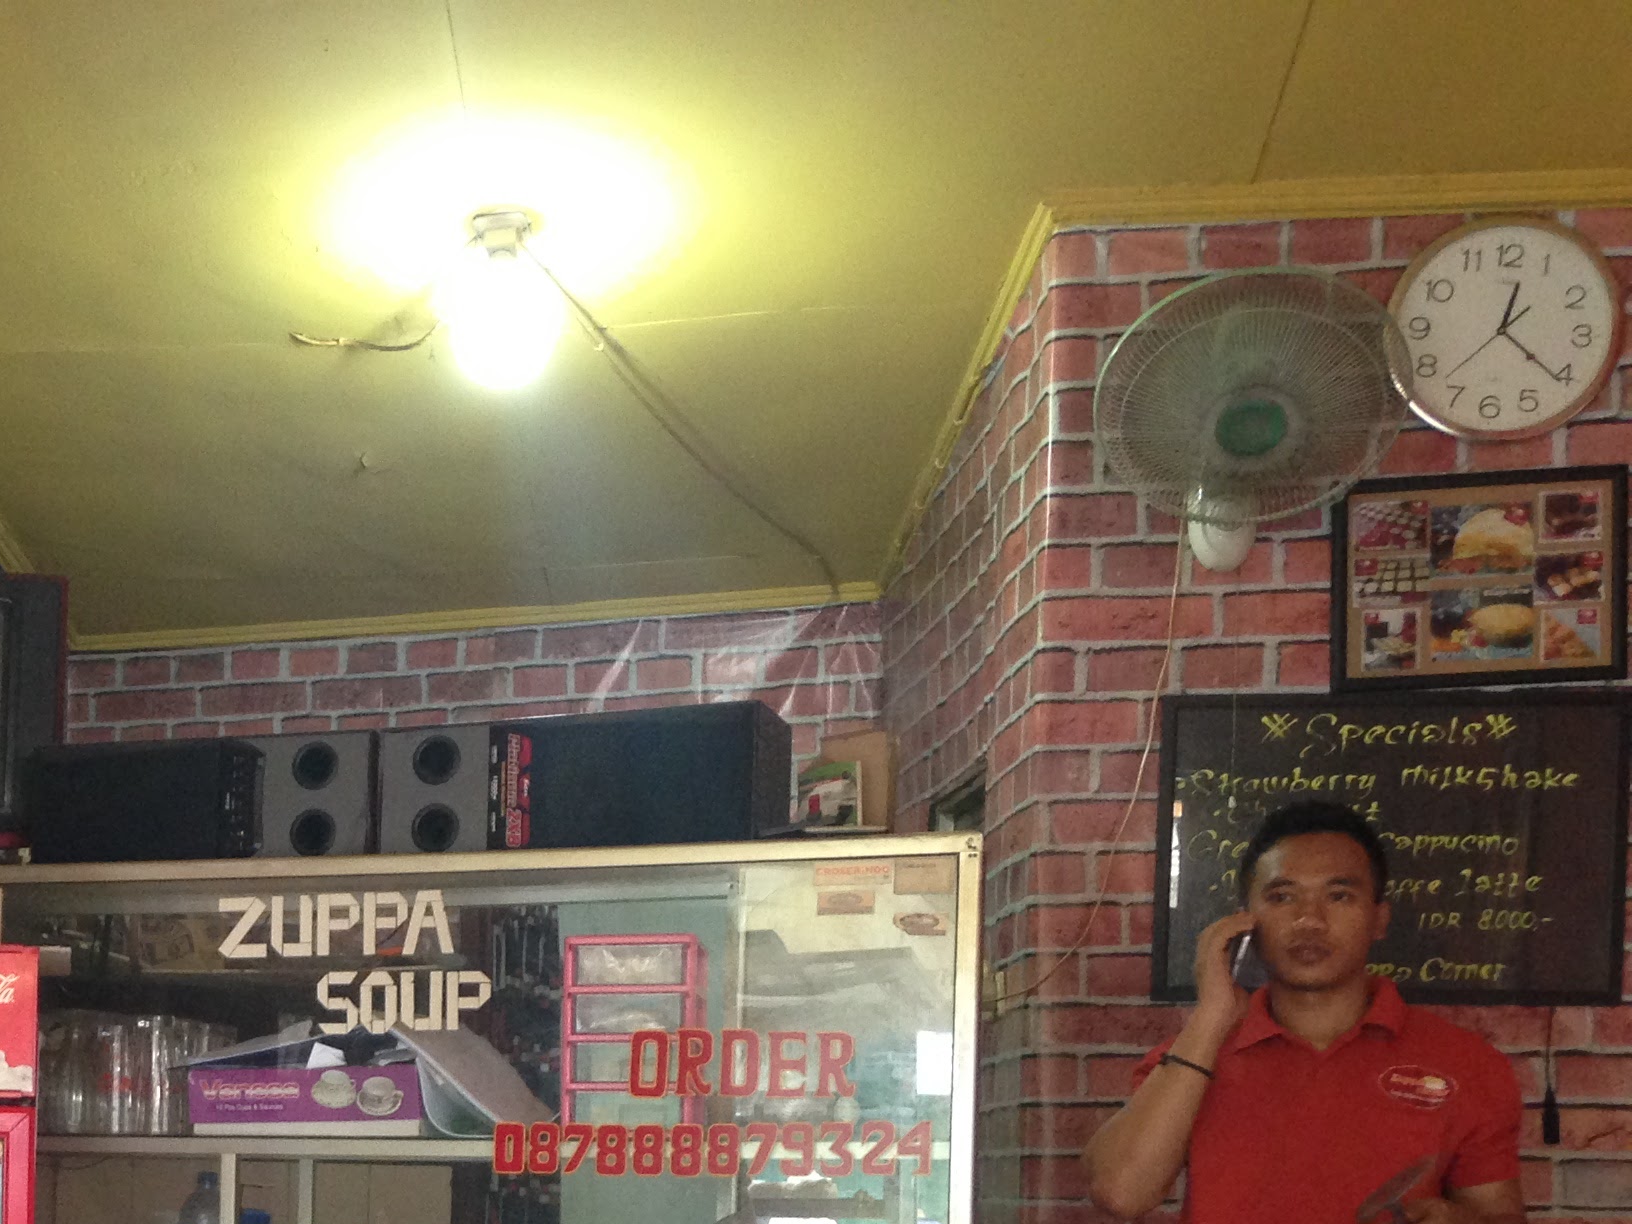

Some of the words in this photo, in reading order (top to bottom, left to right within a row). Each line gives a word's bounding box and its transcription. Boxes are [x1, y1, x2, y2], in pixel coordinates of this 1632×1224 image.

[1462, 248, 1482, 272] 11
[1496, 243, 1525, 268] 12
[1543, 253, 1551, 275] 1
[1426, 278, 1454, 303] 10
[1565, 285, 1587, 309] 2
[1408, 316, 1431, 340] 9
[1572, 324, 1592, 348] 3
[1415, 354, 1438, 378] 8
[1555, 363, 1573, 386] 4
[1446, 385, 1466, 409] 7
[1478, 395, 1500, 419] 6
[1519, 389, 1538, 413] 5
[1300, 712, 1483, 758] Specials
[1191, 766, 1378, 799] Strawberry
[218, 888, 455, 959] ZUPPA
[316, 970, 492, 1035] SOUP
[628, 1027, 857, 1099] ORDER
[492, 1119, 934, 1178] 087888879324
